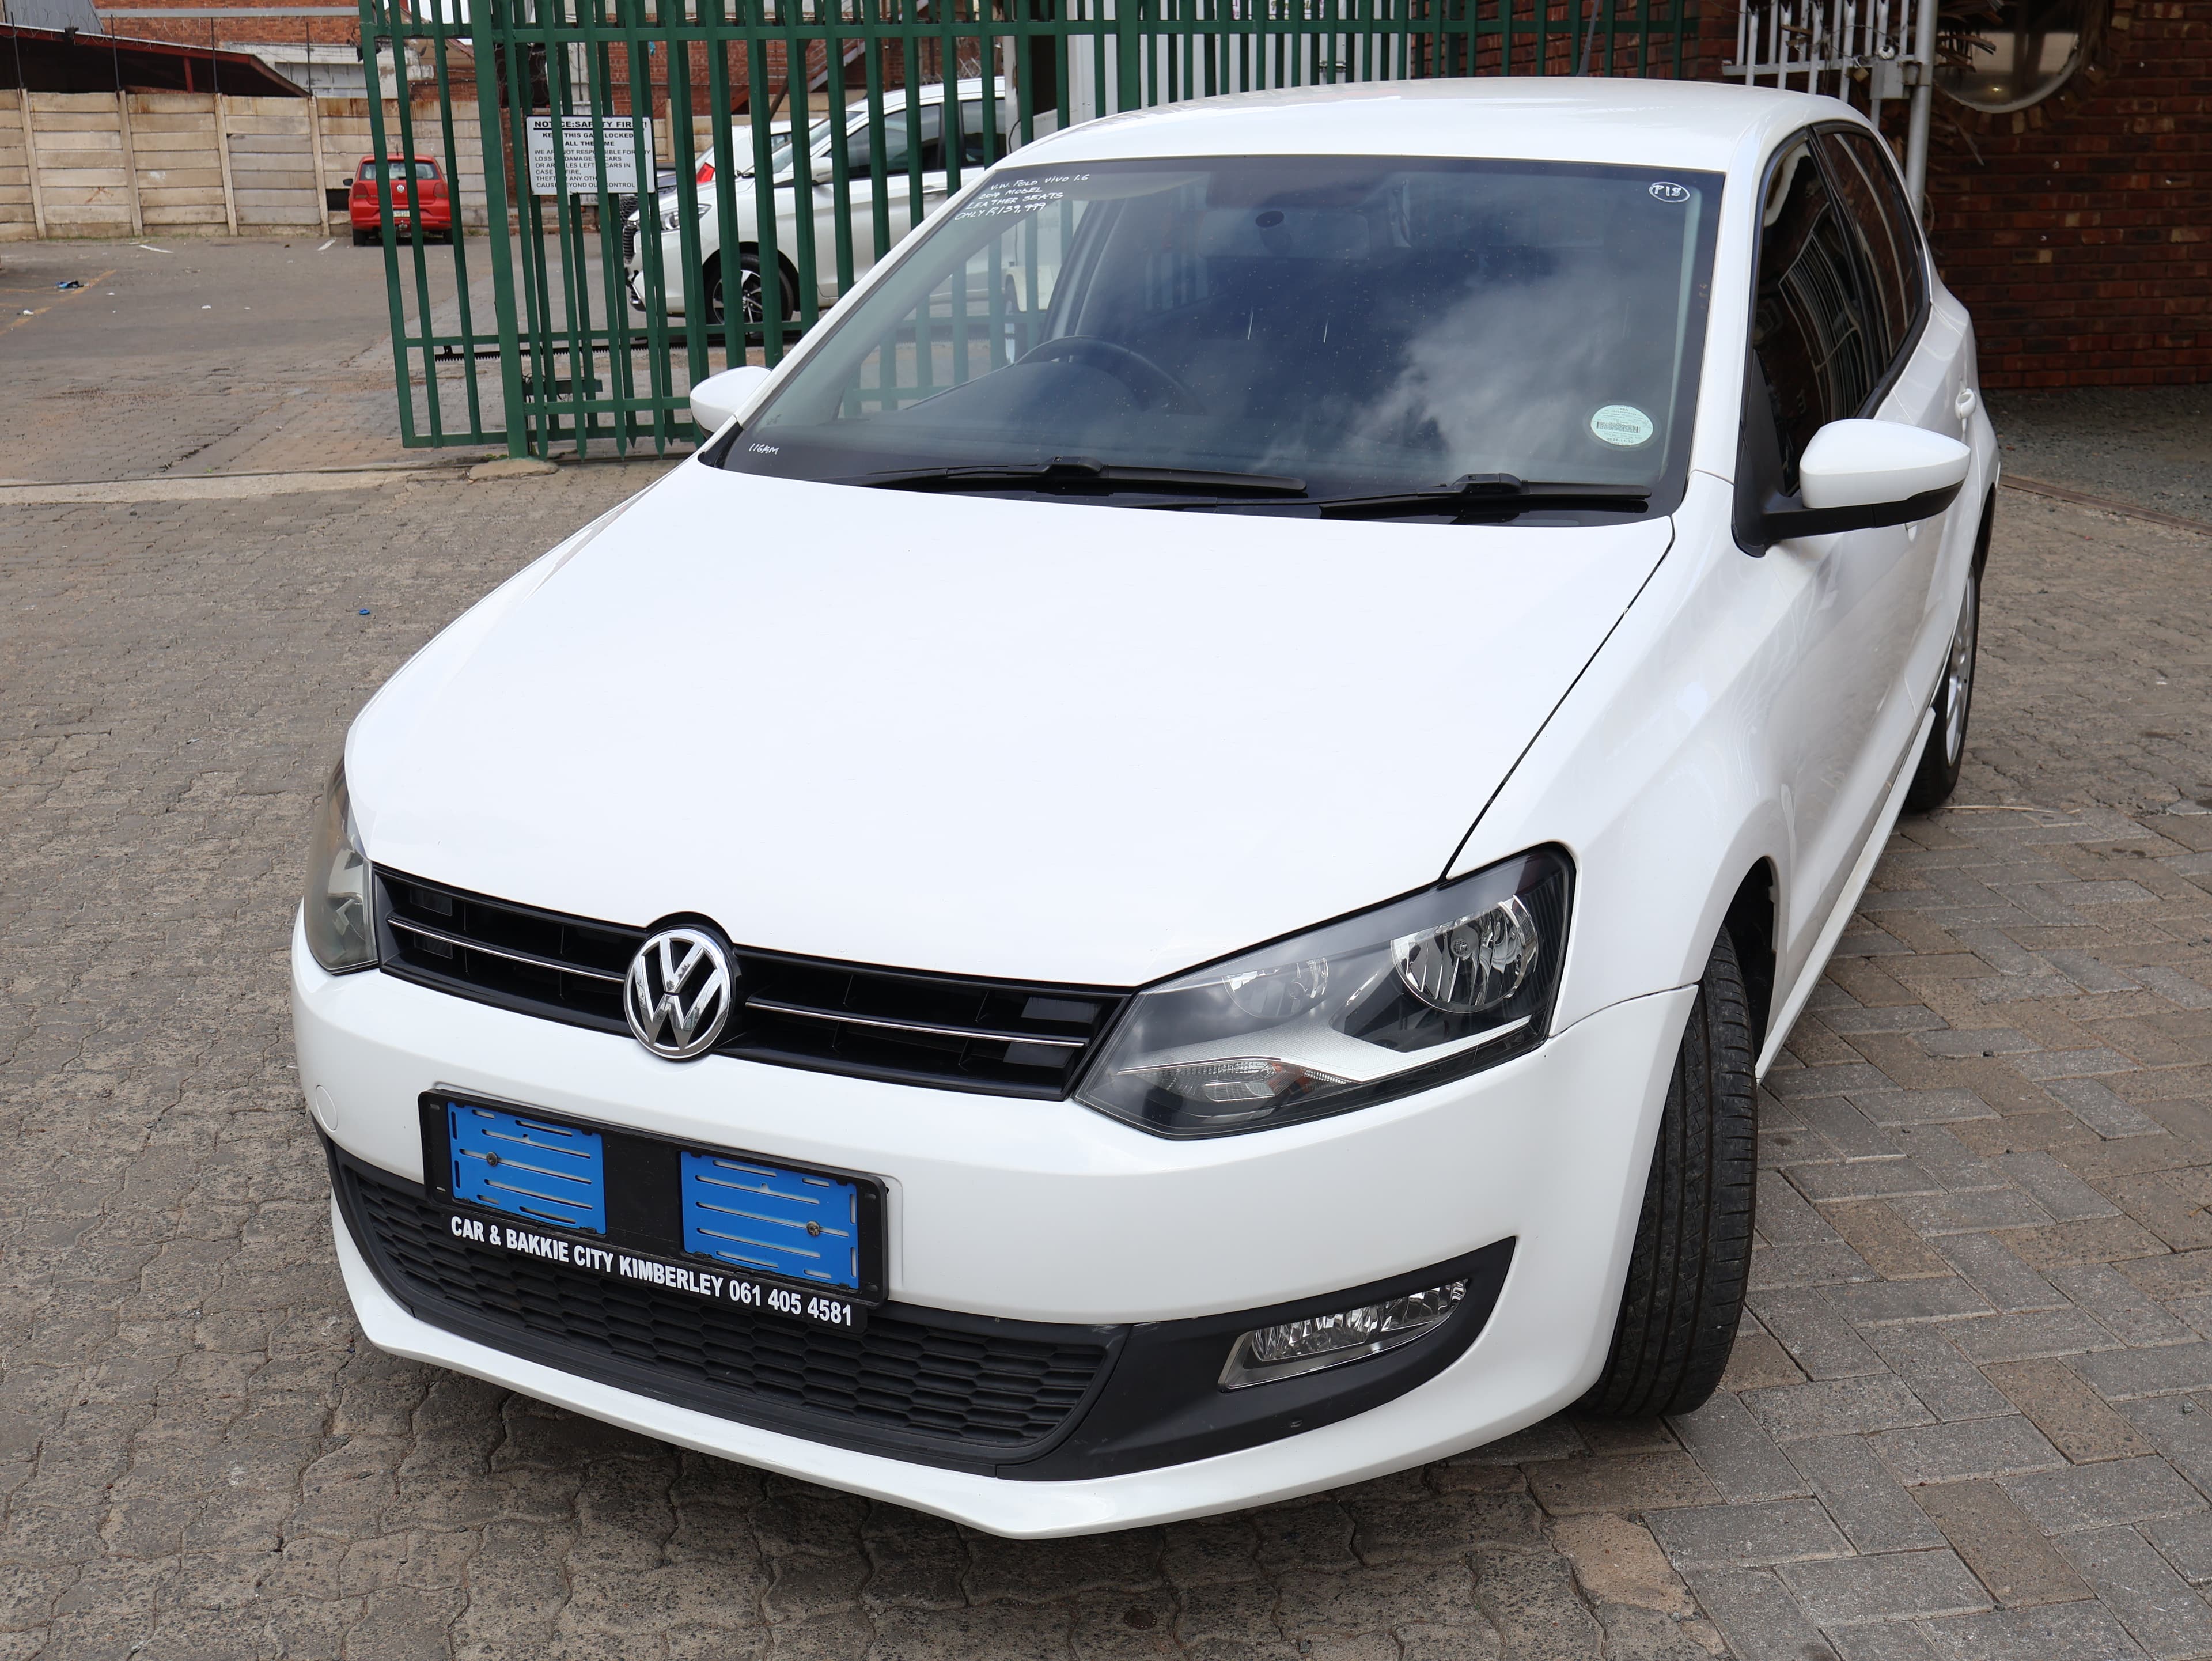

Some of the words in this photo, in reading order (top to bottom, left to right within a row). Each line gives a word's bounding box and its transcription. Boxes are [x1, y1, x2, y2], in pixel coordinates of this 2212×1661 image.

[1073, 173, 1090, 182] 1.6
[1022, 192, 1063, 202] SEATS
[955, 209, 986, 220] ONLY
[451, 1216, 485, 1242] CAR
[489, 1224, 502, 1246] &
[506, 1228, 570, 1263] BAKKIE
[573, 1244, 615, 1273] CITY
[619, 1255, 724, 1297] KIMBERLEY
[729, 1280, 762, 1307] 061
[767, 1288, 802, 1315] 405
[807, 1296, 852, 1327] 4581
